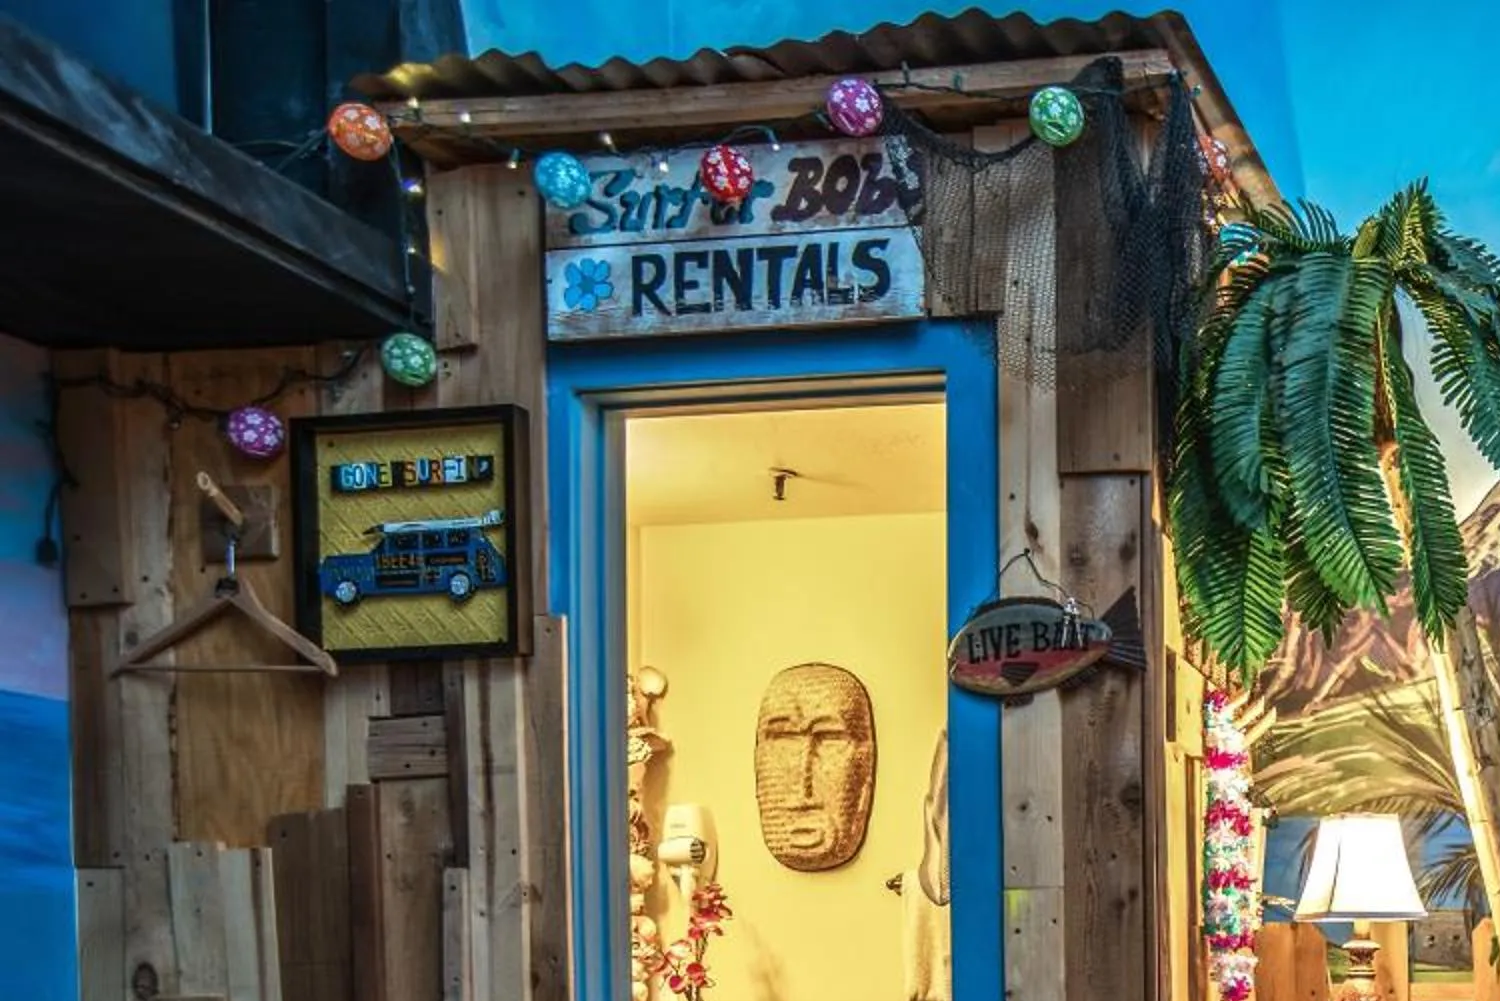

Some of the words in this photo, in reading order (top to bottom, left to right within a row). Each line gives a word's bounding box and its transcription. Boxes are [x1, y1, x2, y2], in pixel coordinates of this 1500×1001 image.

[630, 238, 891, 316] RENTALS
[340, 462, 391, 488] GONE
[966, 622, 1022, 664] LIVE
[1030, 621, 1092, 653] BAIT
